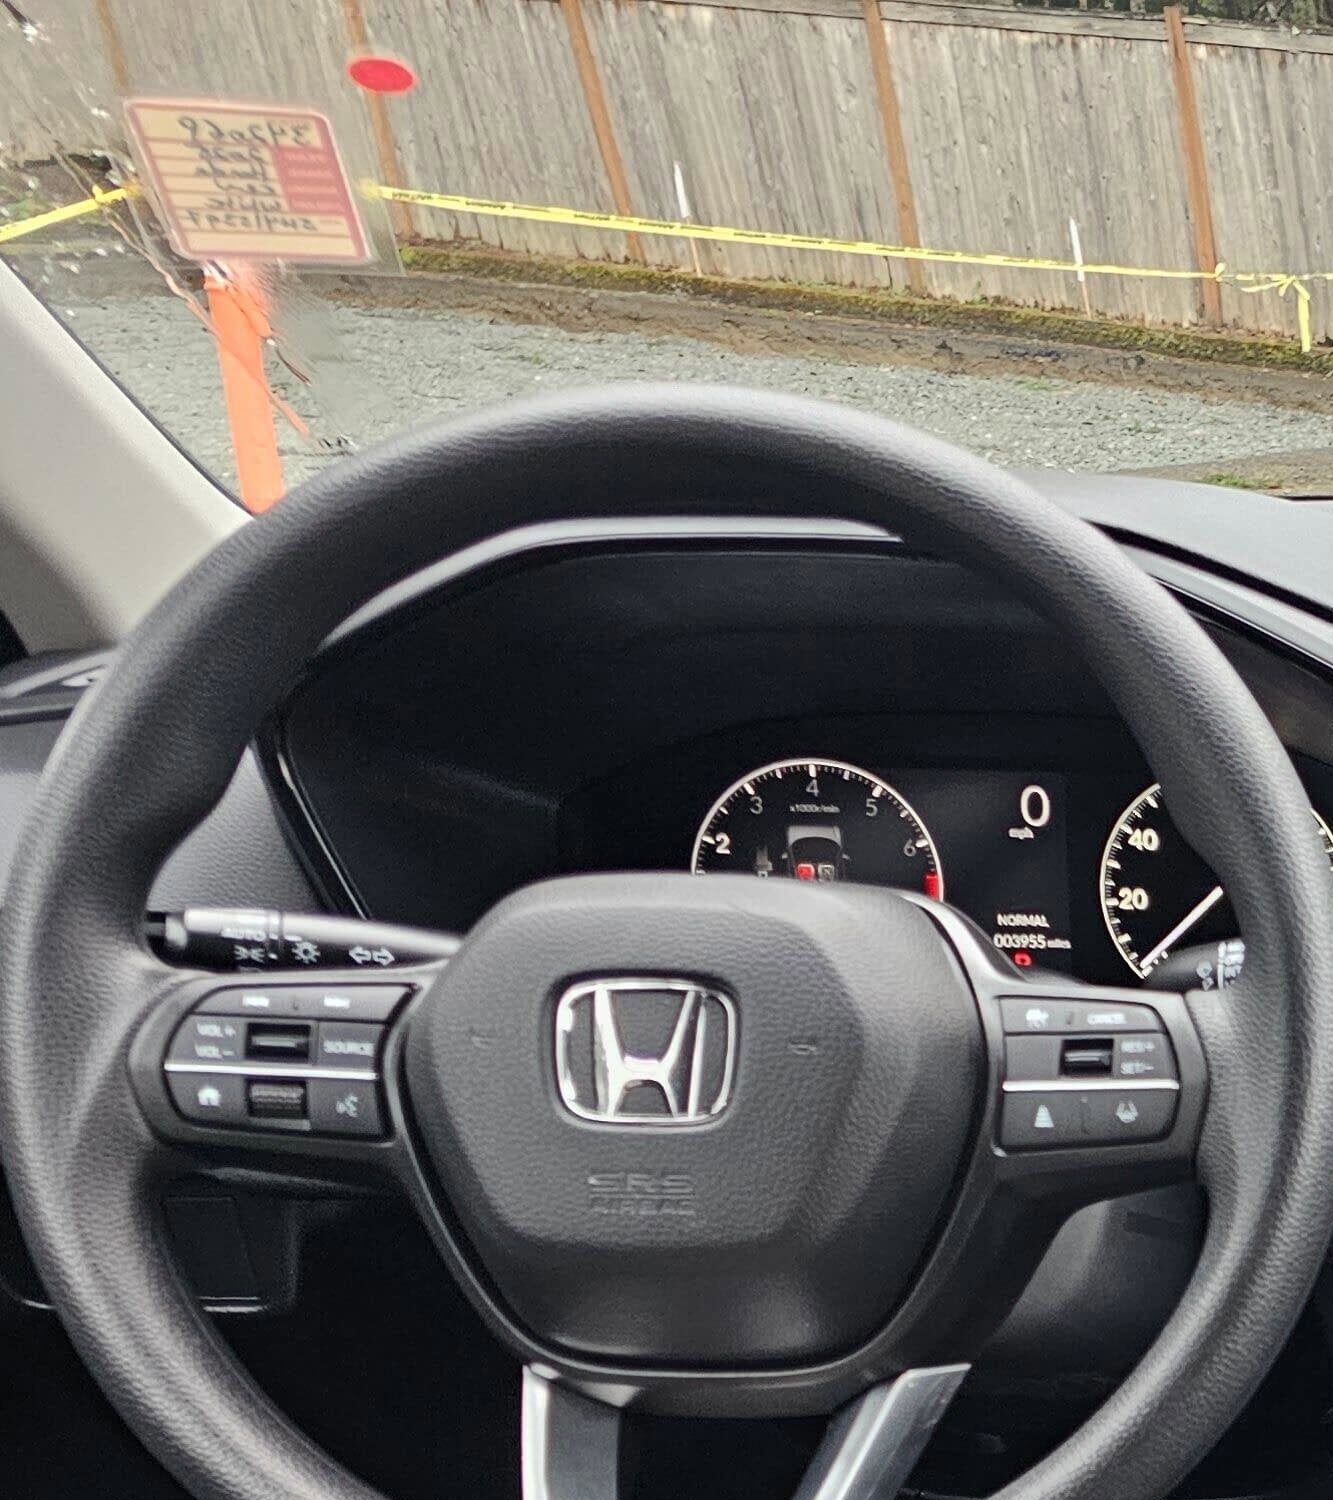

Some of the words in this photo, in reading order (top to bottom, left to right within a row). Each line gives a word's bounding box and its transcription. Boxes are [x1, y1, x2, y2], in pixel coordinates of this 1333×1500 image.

[806, 779, 819, 796] 4
[750, 797, 763, 815] 3
[865, 799, 878, 817] 5
[1020, 785, 1050, 827] 0
[715, 832, 731, 855] 2
[903, 839, 916, 857] 6
[1127, 828, 1160, 851] 40
[1118, 887, 1149, 910] 20
[996, 913, 1050, 928] NORMAL
[993, 933, 1046, 949] 003955
